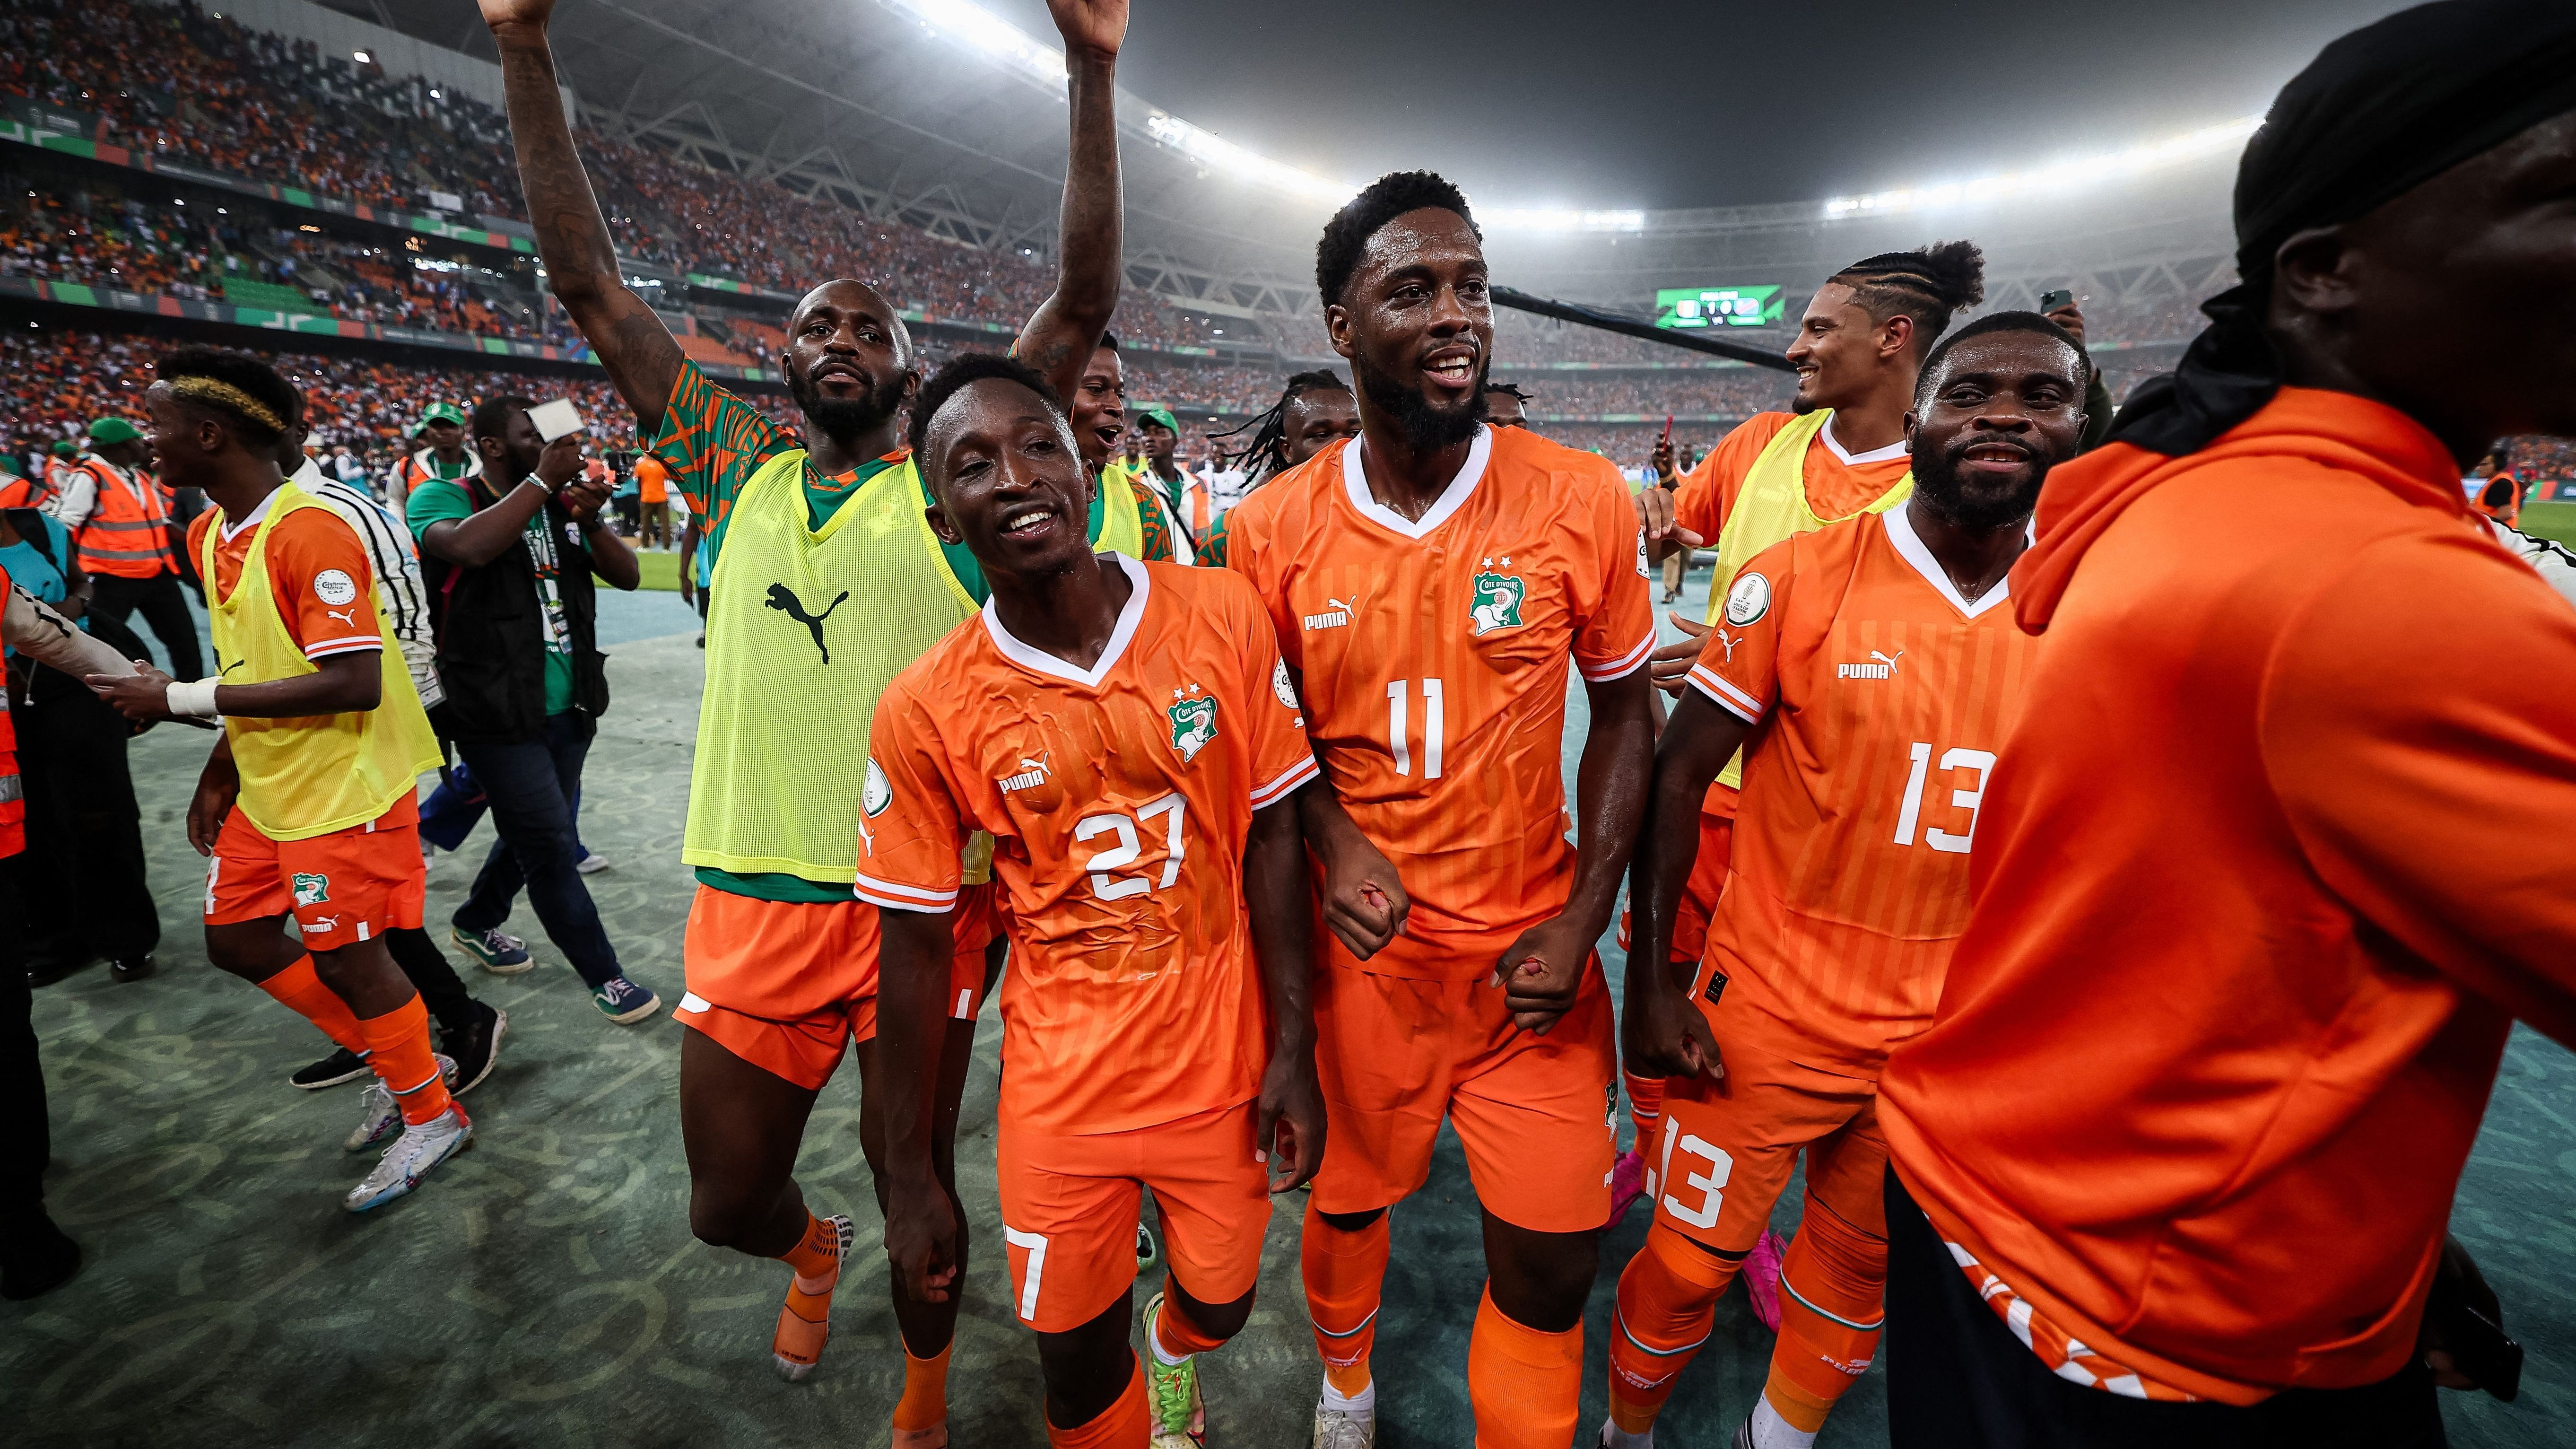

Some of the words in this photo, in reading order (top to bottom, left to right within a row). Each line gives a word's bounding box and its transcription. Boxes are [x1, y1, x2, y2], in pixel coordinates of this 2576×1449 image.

[1496, 581, 1518, 591] D'IVOIRE
[1304, 611, 1347, 631] PUMA
[1838, 663, 1889, 679] PUMA
[1192, 699, 1212, 712] D'IVOIRE
[1387, 678, 1444, 779] 11
[998, 769, 1045, 794] PUMA
[1893, 742, 1998, 854] 13
[1074, 792, 1188, 901] 27
[1603, 1166, 1614, 1188] PU
[1001, 1218, 1049, 1321] 7
